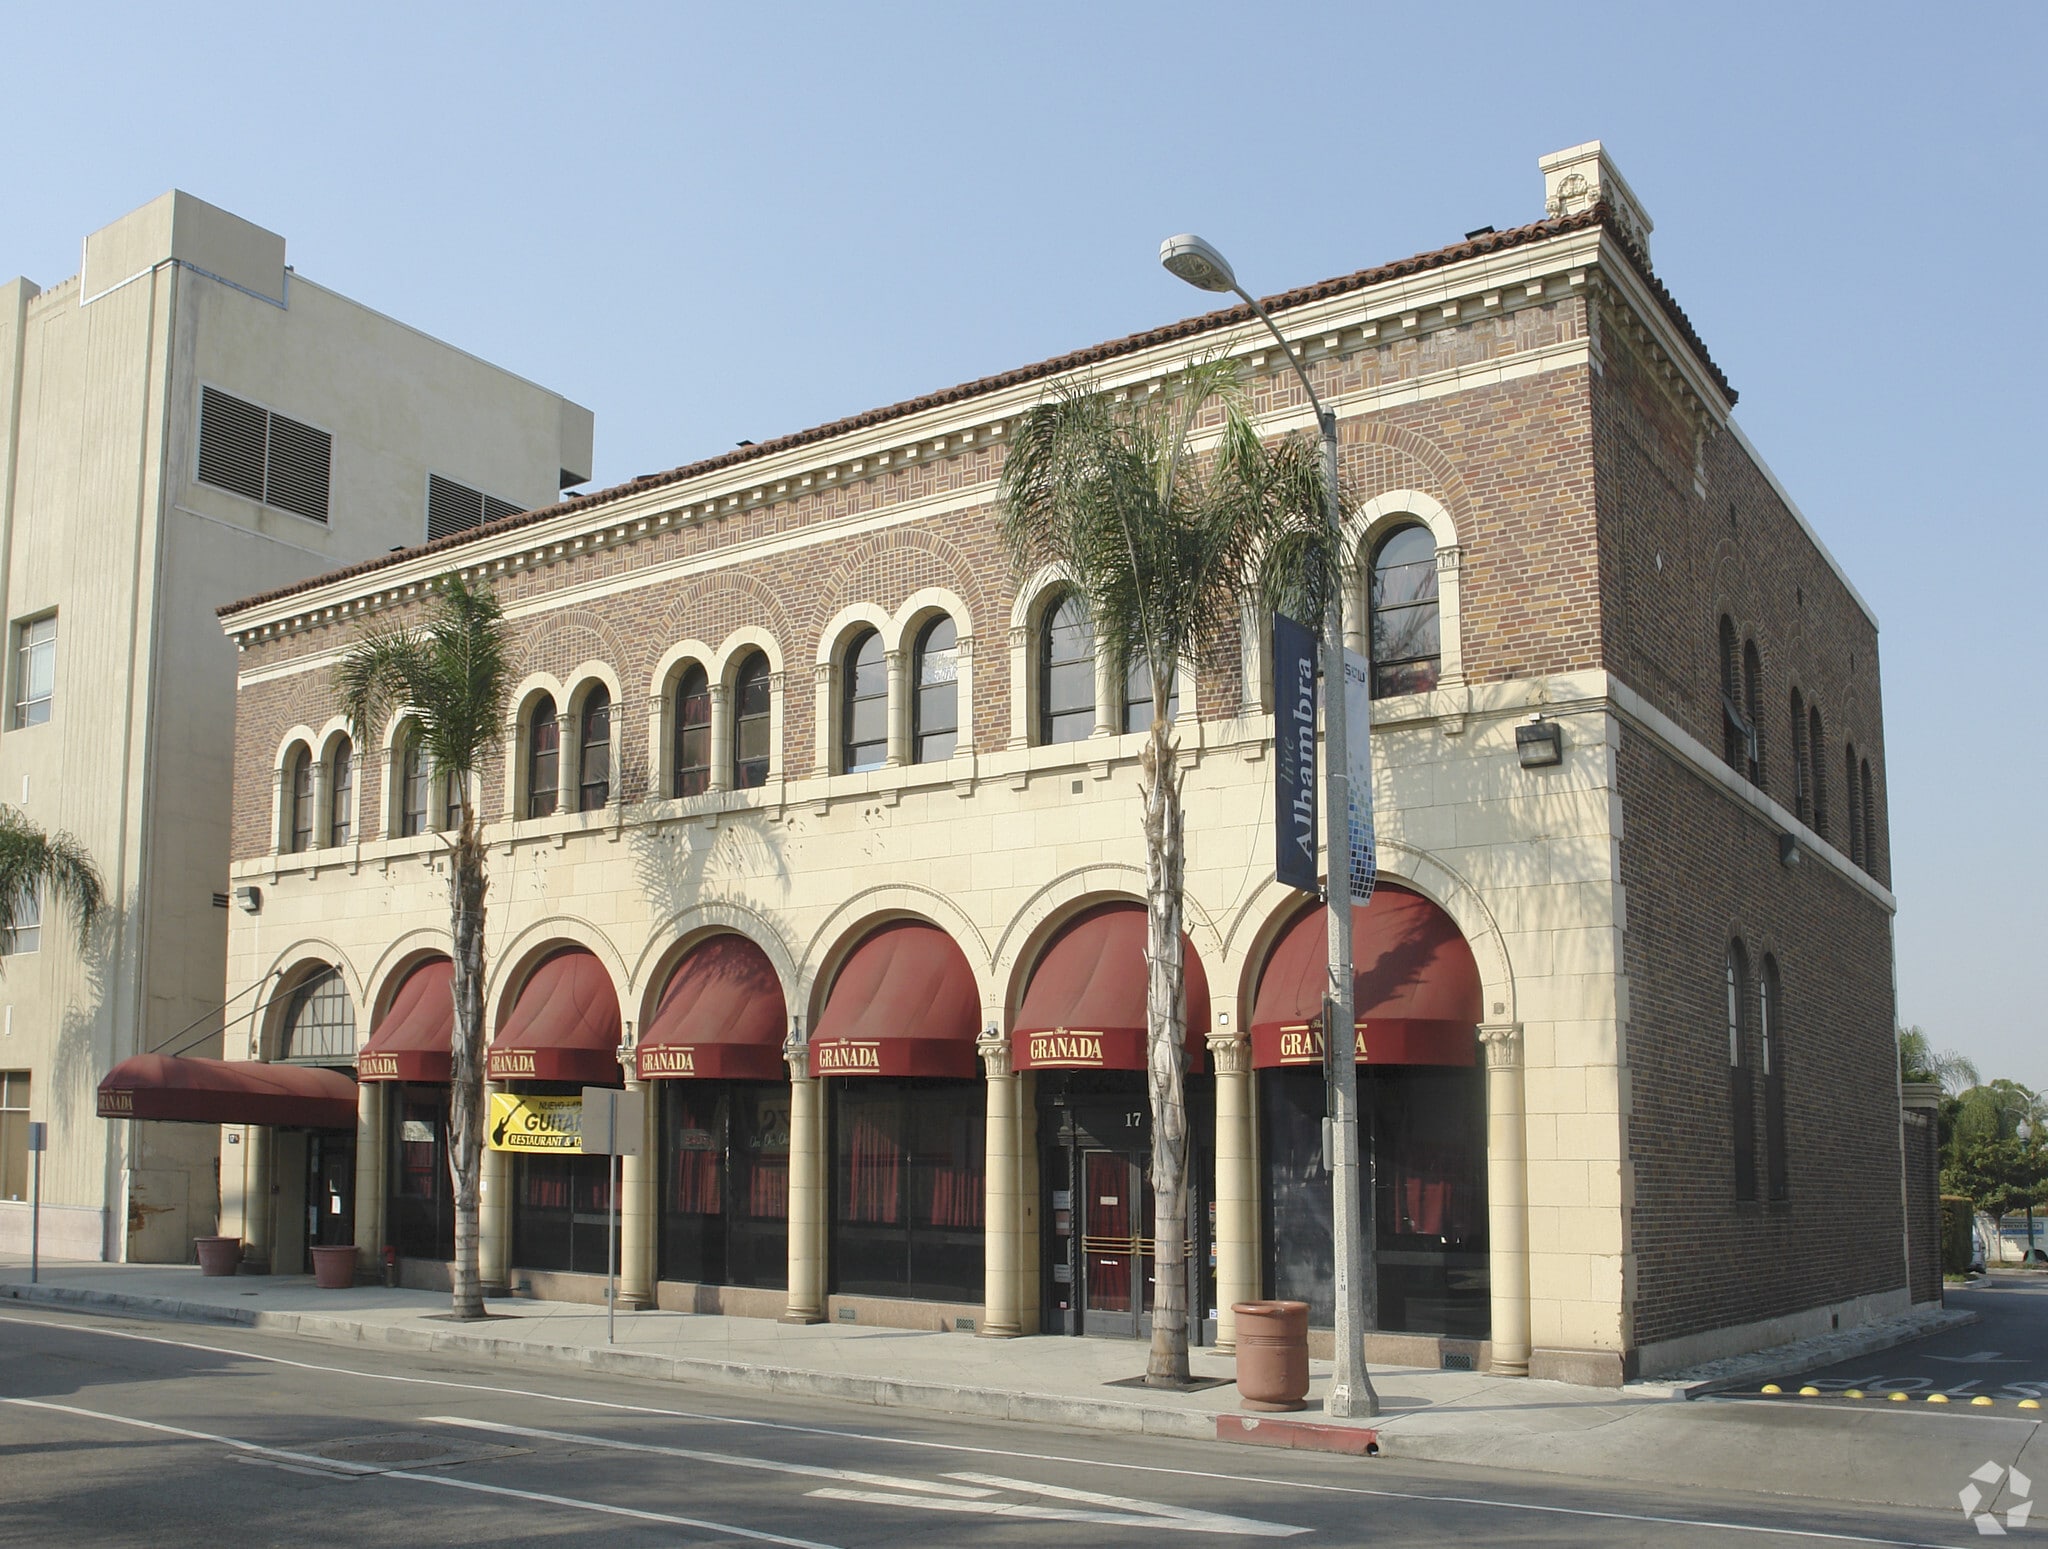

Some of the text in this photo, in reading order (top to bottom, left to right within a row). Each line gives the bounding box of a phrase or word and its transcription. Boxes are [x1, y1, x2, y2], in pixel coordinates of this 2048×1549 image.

[1281, 736, 1296, 785] live
[1293, 657, 1313, 862] Alhambra
[1030, 1038, 1103, 1060] GRANADA
[1280, 1031, 1367, 1056] GRANA
[490, 1055, 535, 1072] GRANADA
[642, 1053, 695, 1071] GRANADA
[819, 1048, 880, 1067] GRANADA
[1124, 1112, 1142, 1127] 17
[510, 1134, 562, 1147] RESTAURANT
[563, 1136, 571, 1147] &
[1803, 1375, 2048, 1400] STOP
